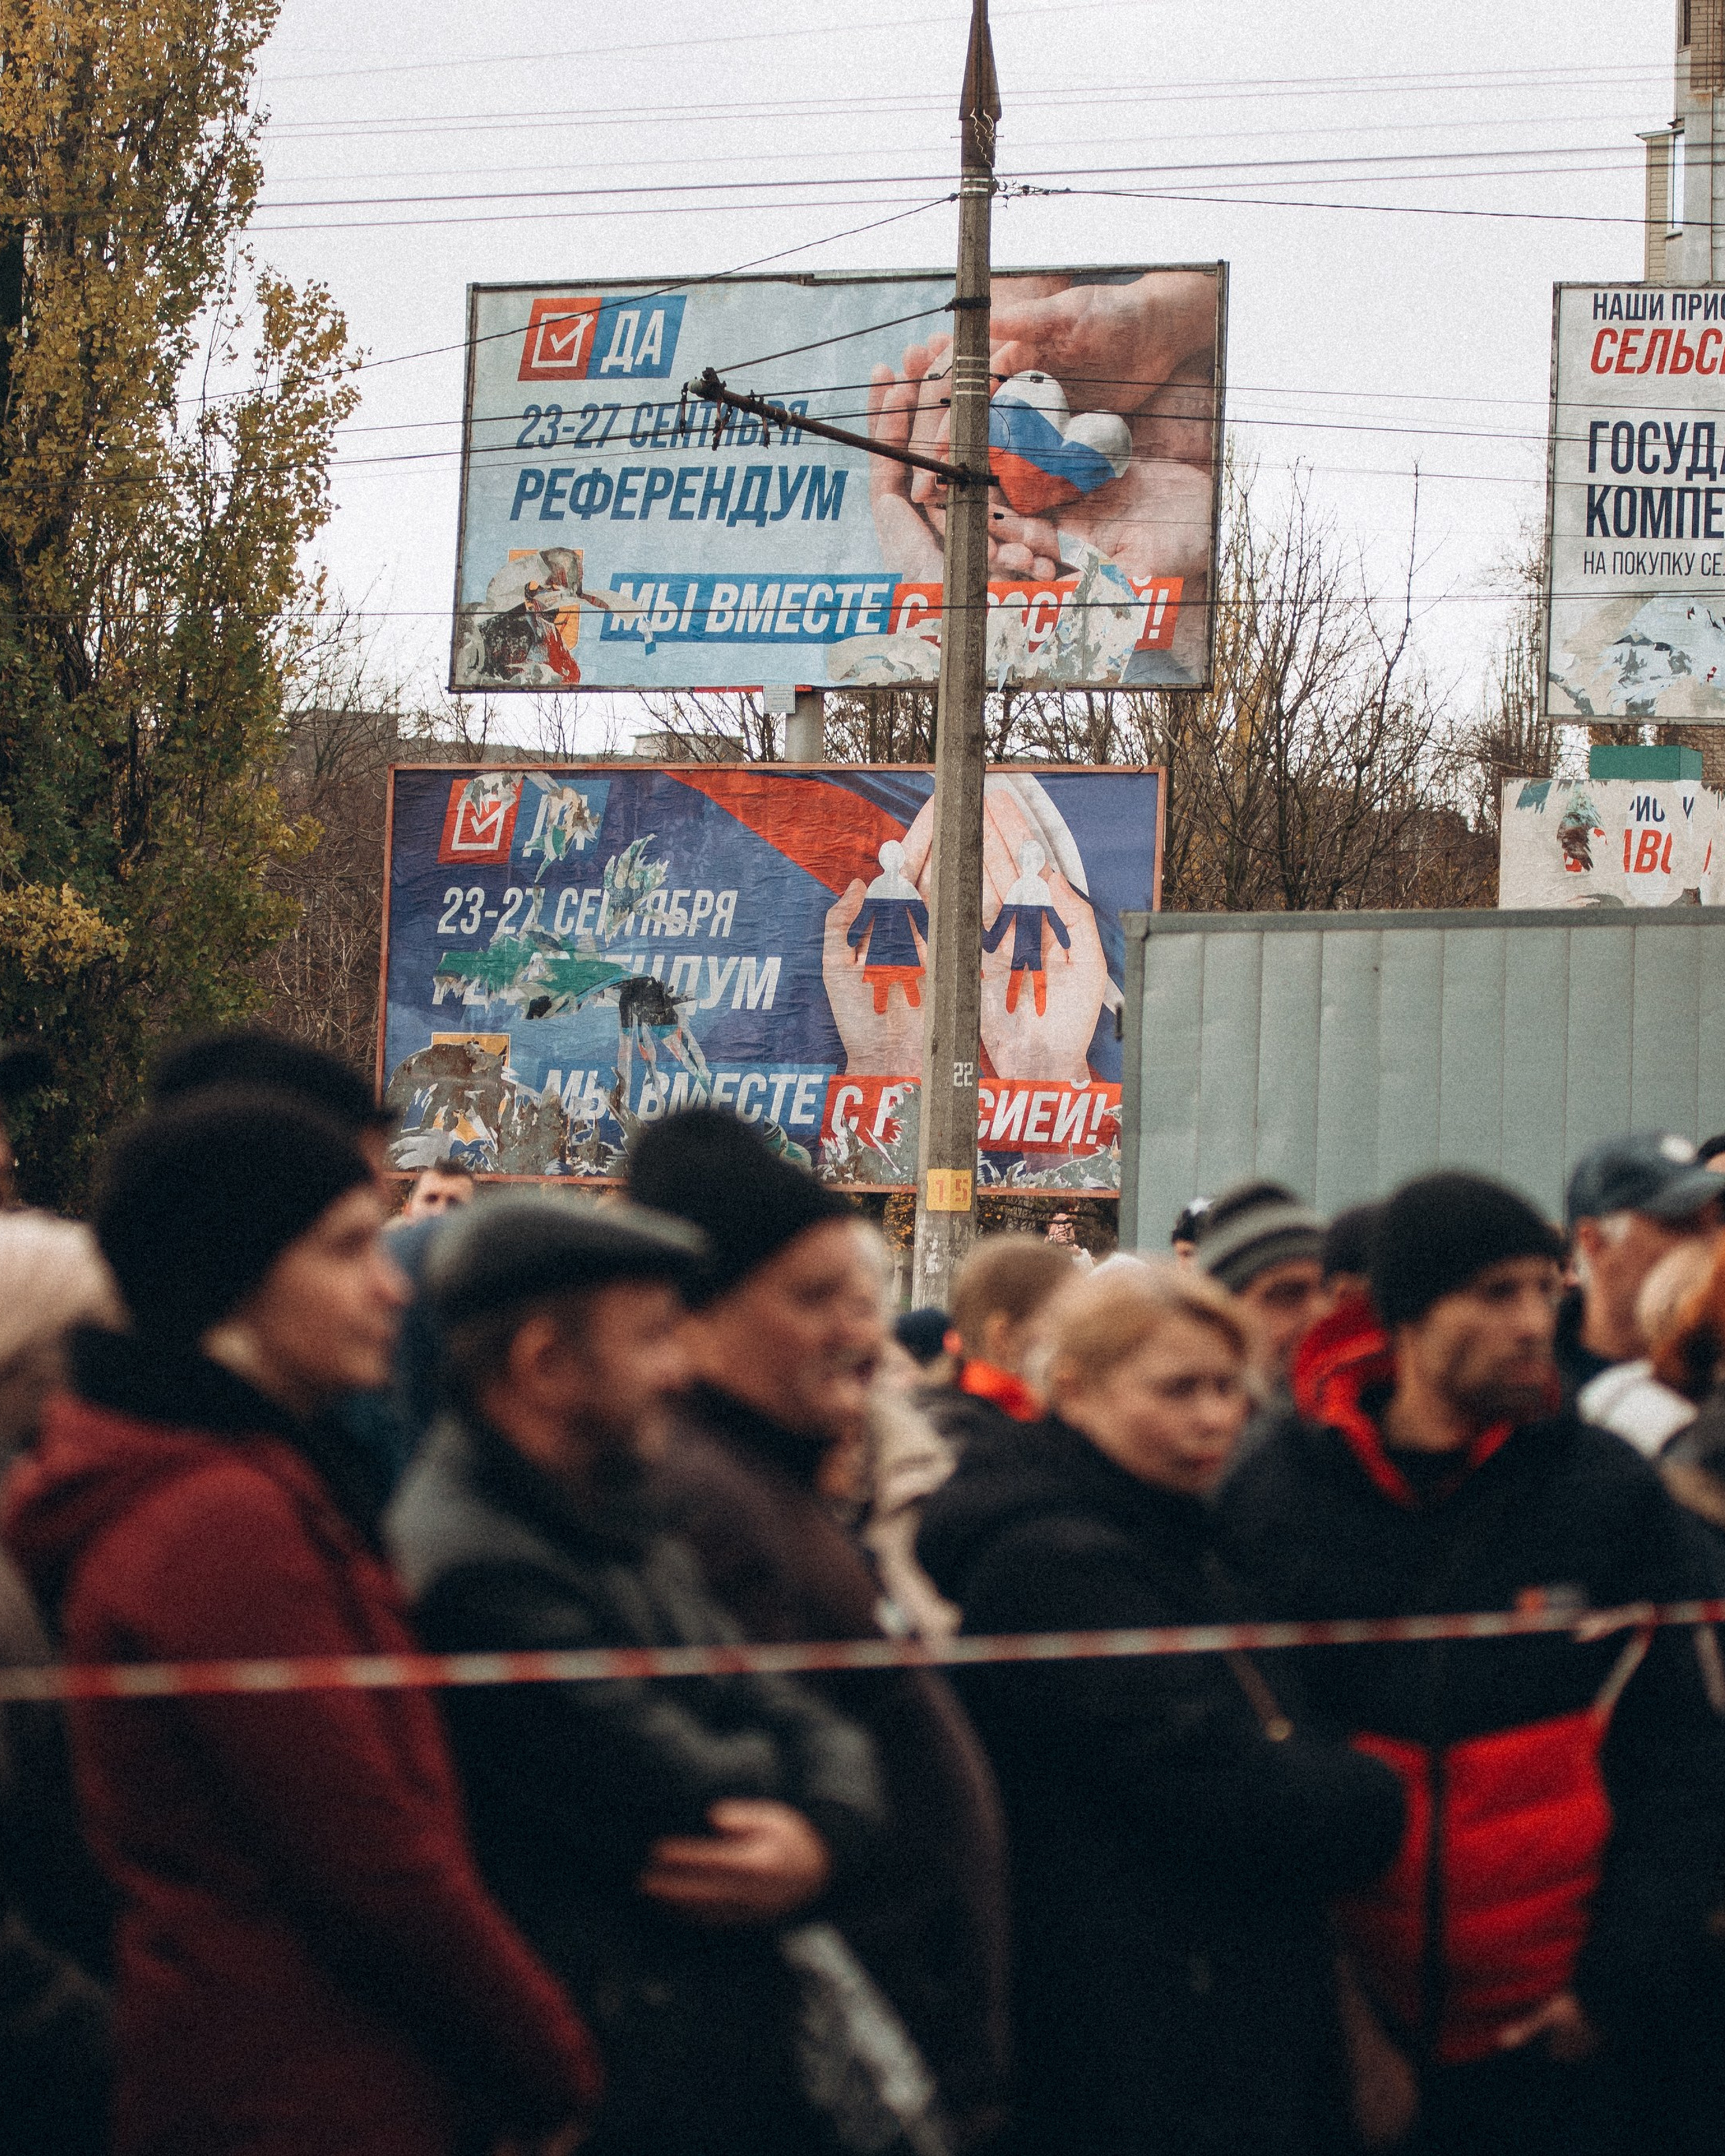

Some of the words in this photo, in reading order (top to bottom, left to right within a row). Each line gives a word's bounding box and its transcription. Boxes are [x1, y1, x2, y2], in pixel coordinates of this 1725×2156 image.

[1592, 292, 1664, 321] НАШИ
[600, 309, 664, 373] ДА
[1590, 327, 1725, 375] СЕЛЬС
[515, 403, 622, 449] 23-27
[1588, 420, 1725, 482] ГОСУД
[509, 465, 849, 528] РЕФЕРЕНДУМ
[1586, 483, 1724, 539] КОМПЕ
[1583, 550, 1606, 575] НА
[1612, 551, 1696, 577] ПОКУПКУ
[1701, 552, 1725, 577] СЕ
[610, 582, 698, 633] МЫ
[705, 581, 889, 635] ВМЕСТЕ
[873, 1079, 1108, 1145] РСИЕЙ!
